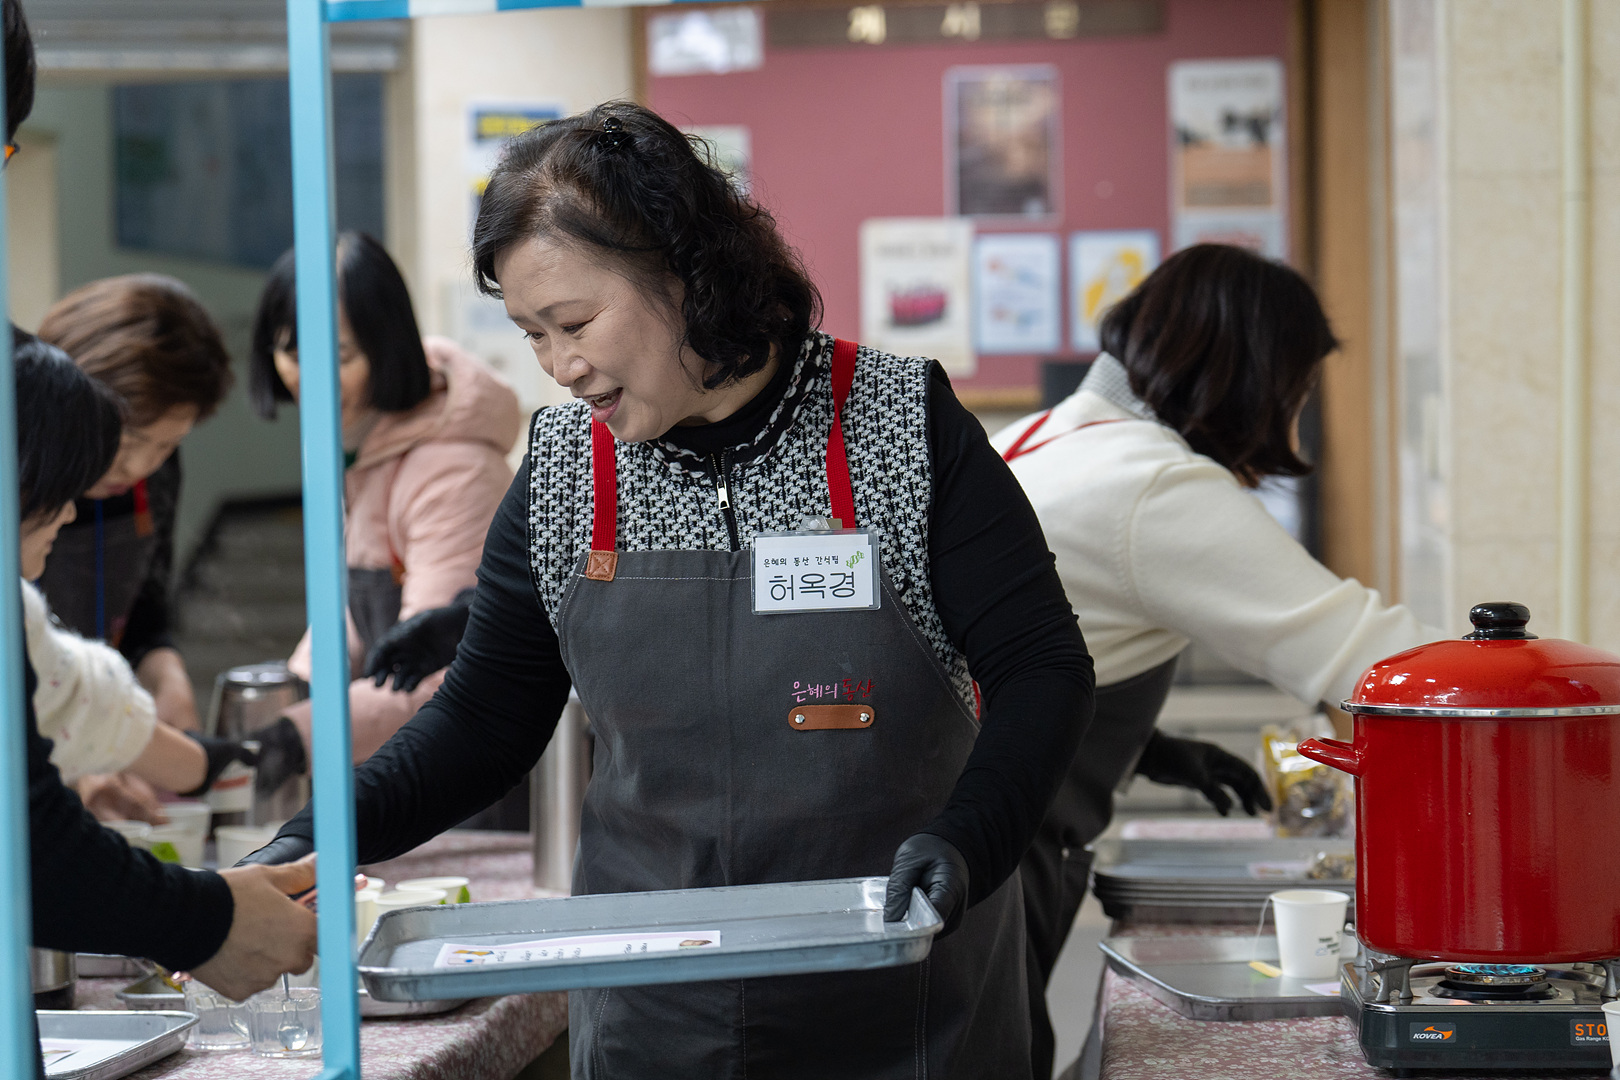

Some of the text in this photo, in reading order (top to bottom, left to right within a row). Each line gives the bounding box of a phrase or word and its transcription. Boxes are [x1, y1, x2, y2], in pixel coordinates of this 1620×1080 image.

[764, 558, 787, 568] 은혜의
[793, 557, 809, 566] 동산
[769, 571, 856, 601] 허옥경
[791, 679, 876, 702] 은혜의 동산
